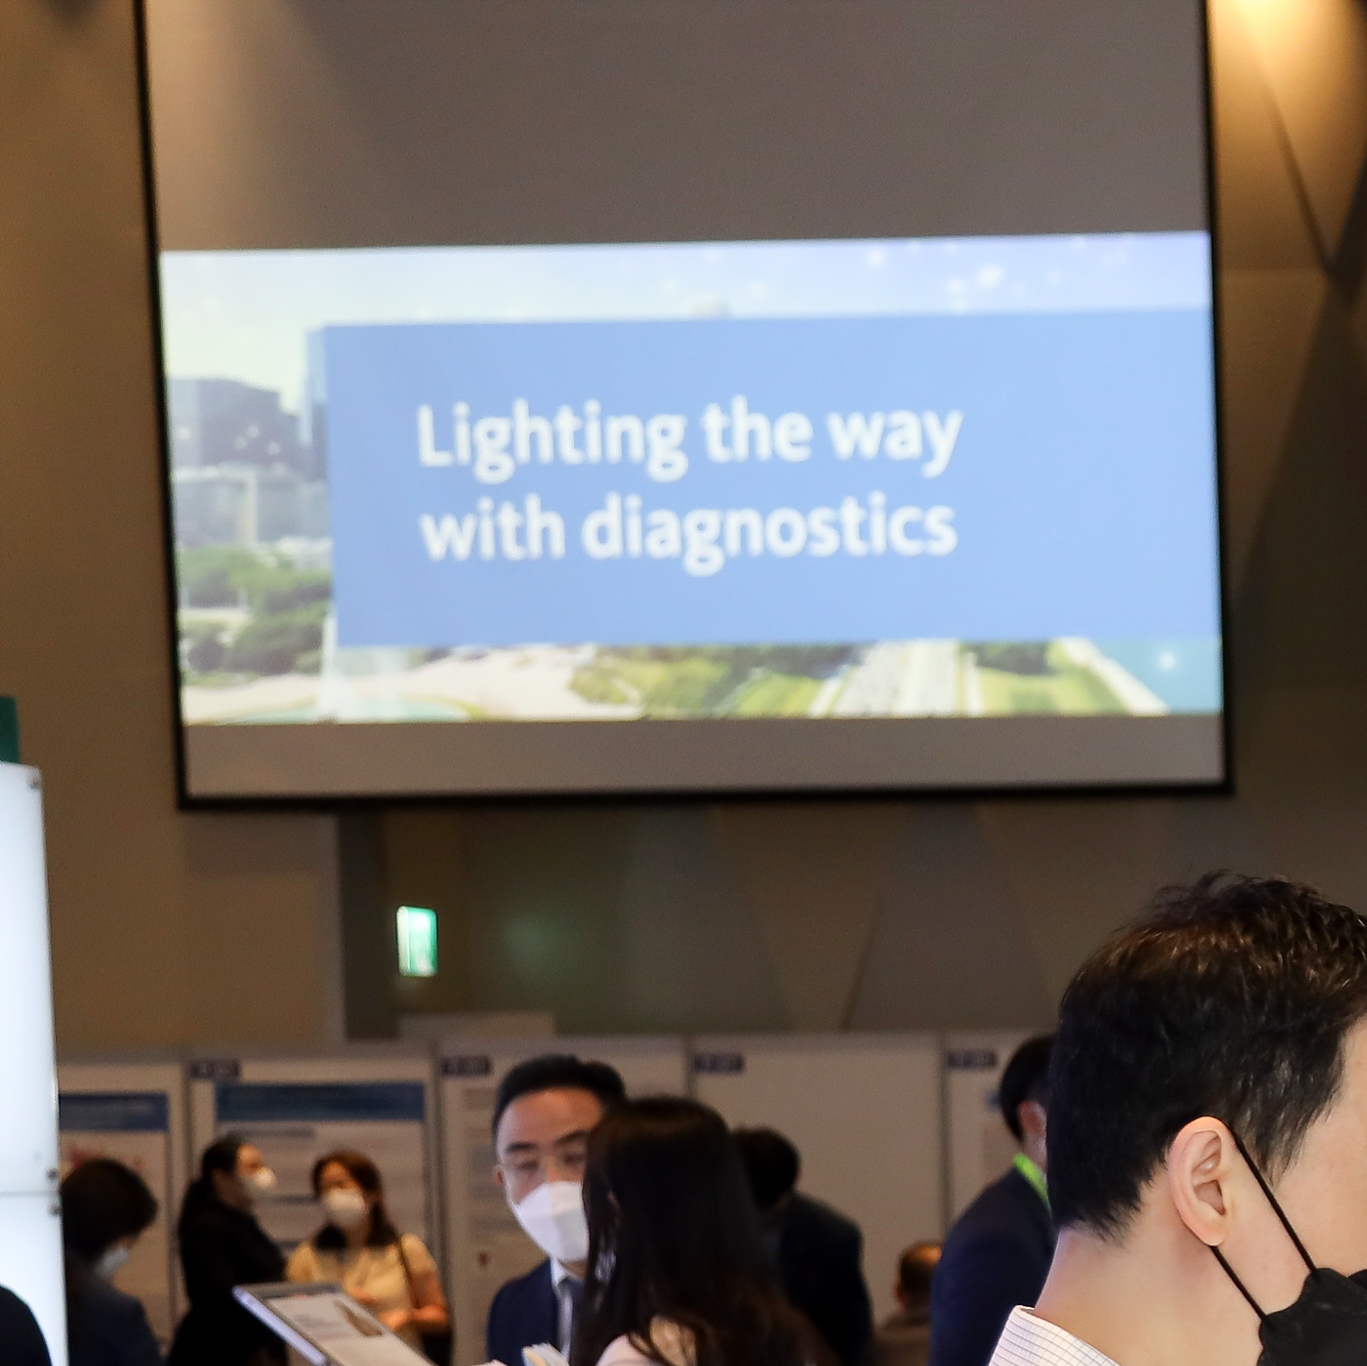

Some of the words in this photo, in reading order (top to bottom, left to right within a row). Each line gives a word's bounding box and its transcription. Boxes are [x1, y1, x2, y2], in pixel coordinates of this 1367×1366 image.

[416, 396, 688, 483] Lighting
[704, 396, 813, 461] the
[828, 410, 963, 479] way
[420, 495, 567, 561] with
[580, 491, 958, 576] diagnostics
